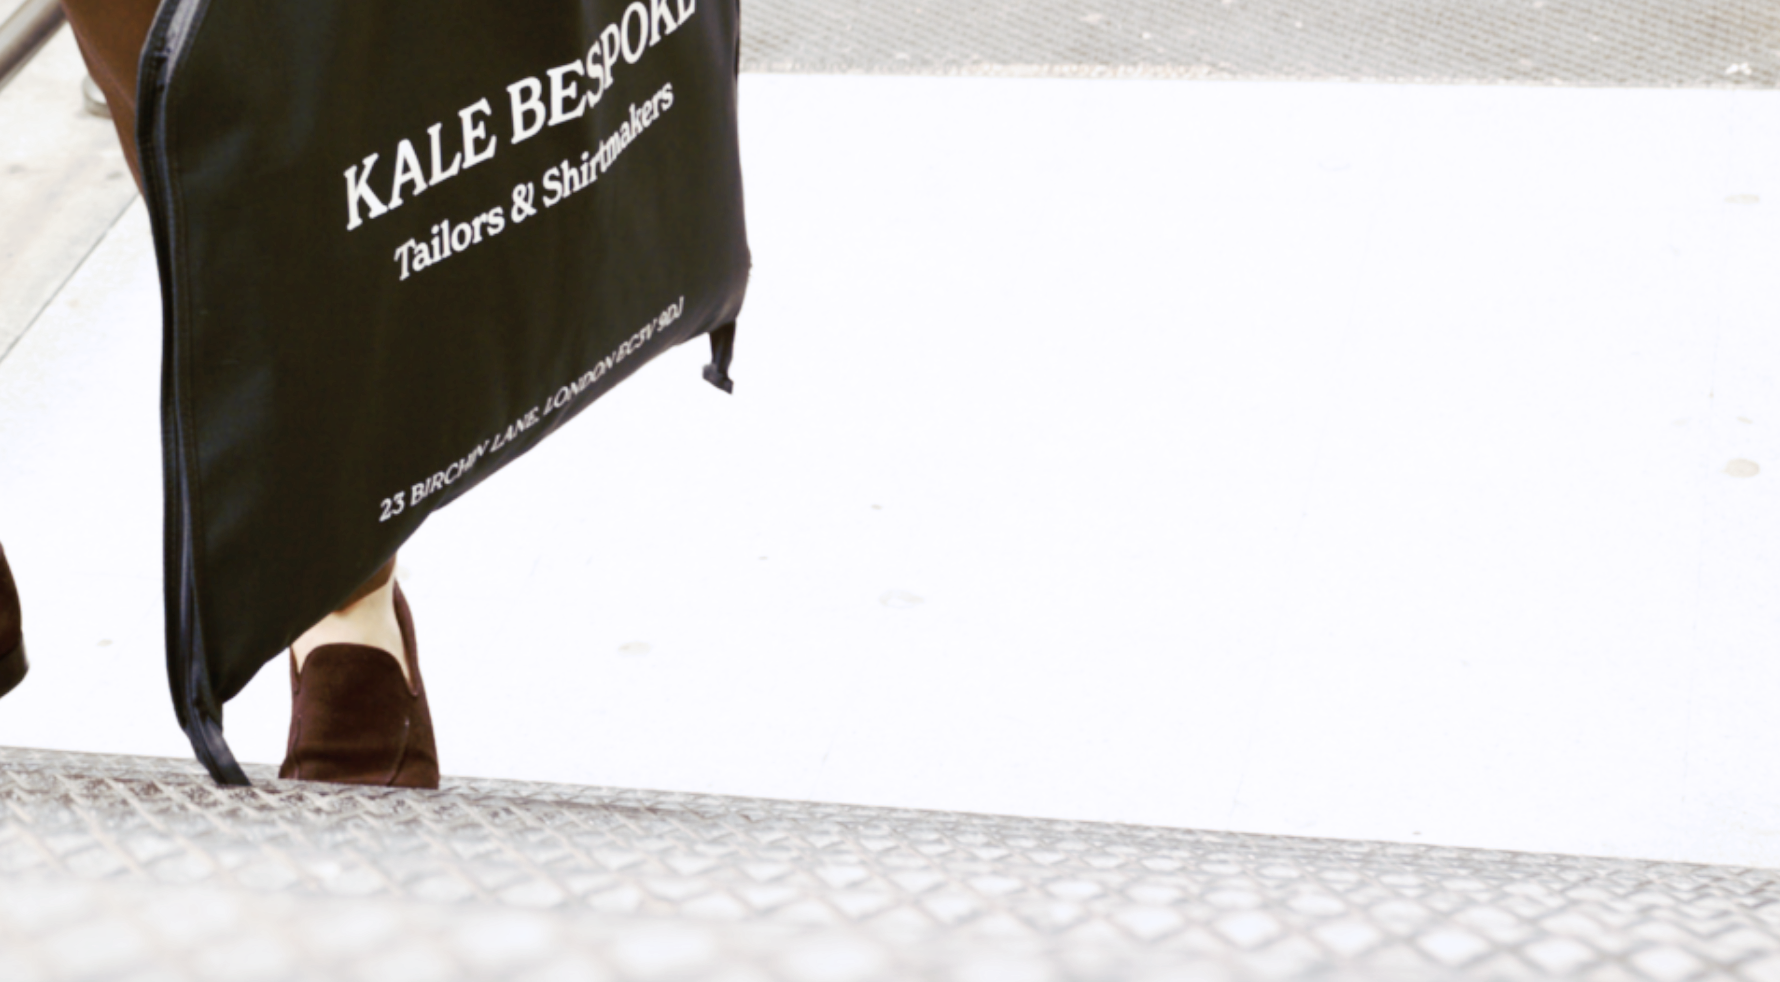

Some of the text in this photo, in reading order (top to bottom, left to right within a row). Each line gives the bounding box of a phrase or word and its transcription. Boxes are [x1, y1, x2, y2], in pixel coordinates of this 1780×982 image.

[343, 98, 497, 231] KALE
[393, 82, 674, 281] Tailors & Shirtmakers
[379, 490, 406, 522] 23
[410, 439, 490, 506] BIRCHIN
[543, 350, 617, 416] LONDON
